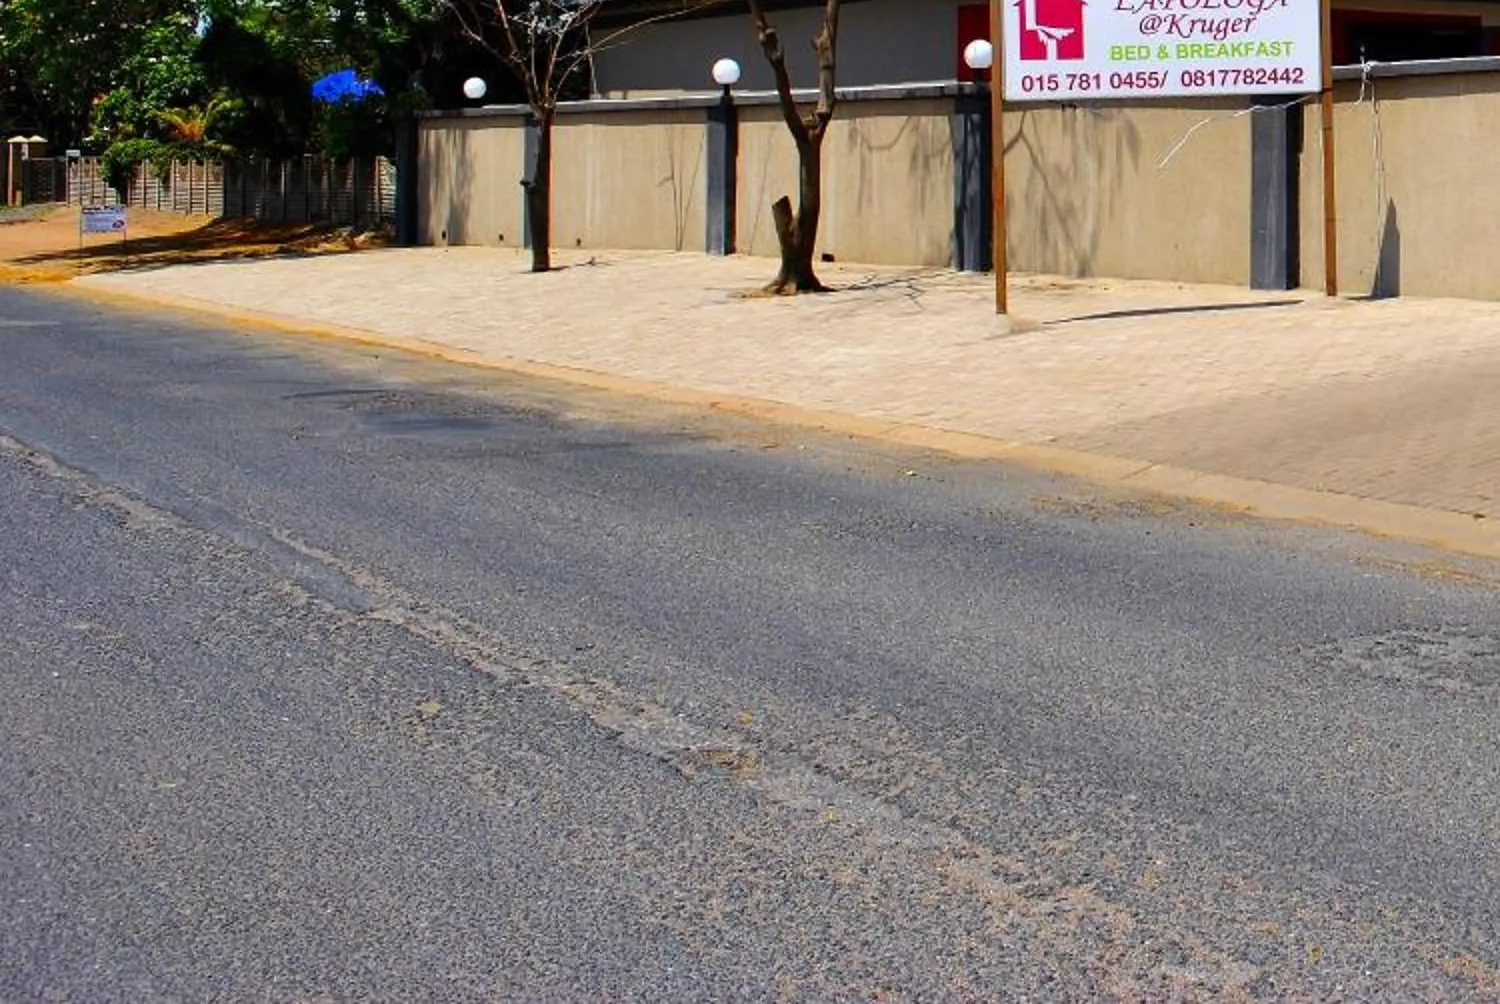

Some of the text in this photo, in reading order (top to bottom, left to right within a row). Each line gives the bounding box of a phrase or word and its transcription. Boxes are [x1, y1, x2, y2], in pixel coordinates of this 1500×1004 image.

[1139, 11, 1257, 41] @Kruger
[1110, 41, 1294, 61] BED & BREAKFAST
[1021, 67, 1304, 93] 015 781 0455/ 0817782442
